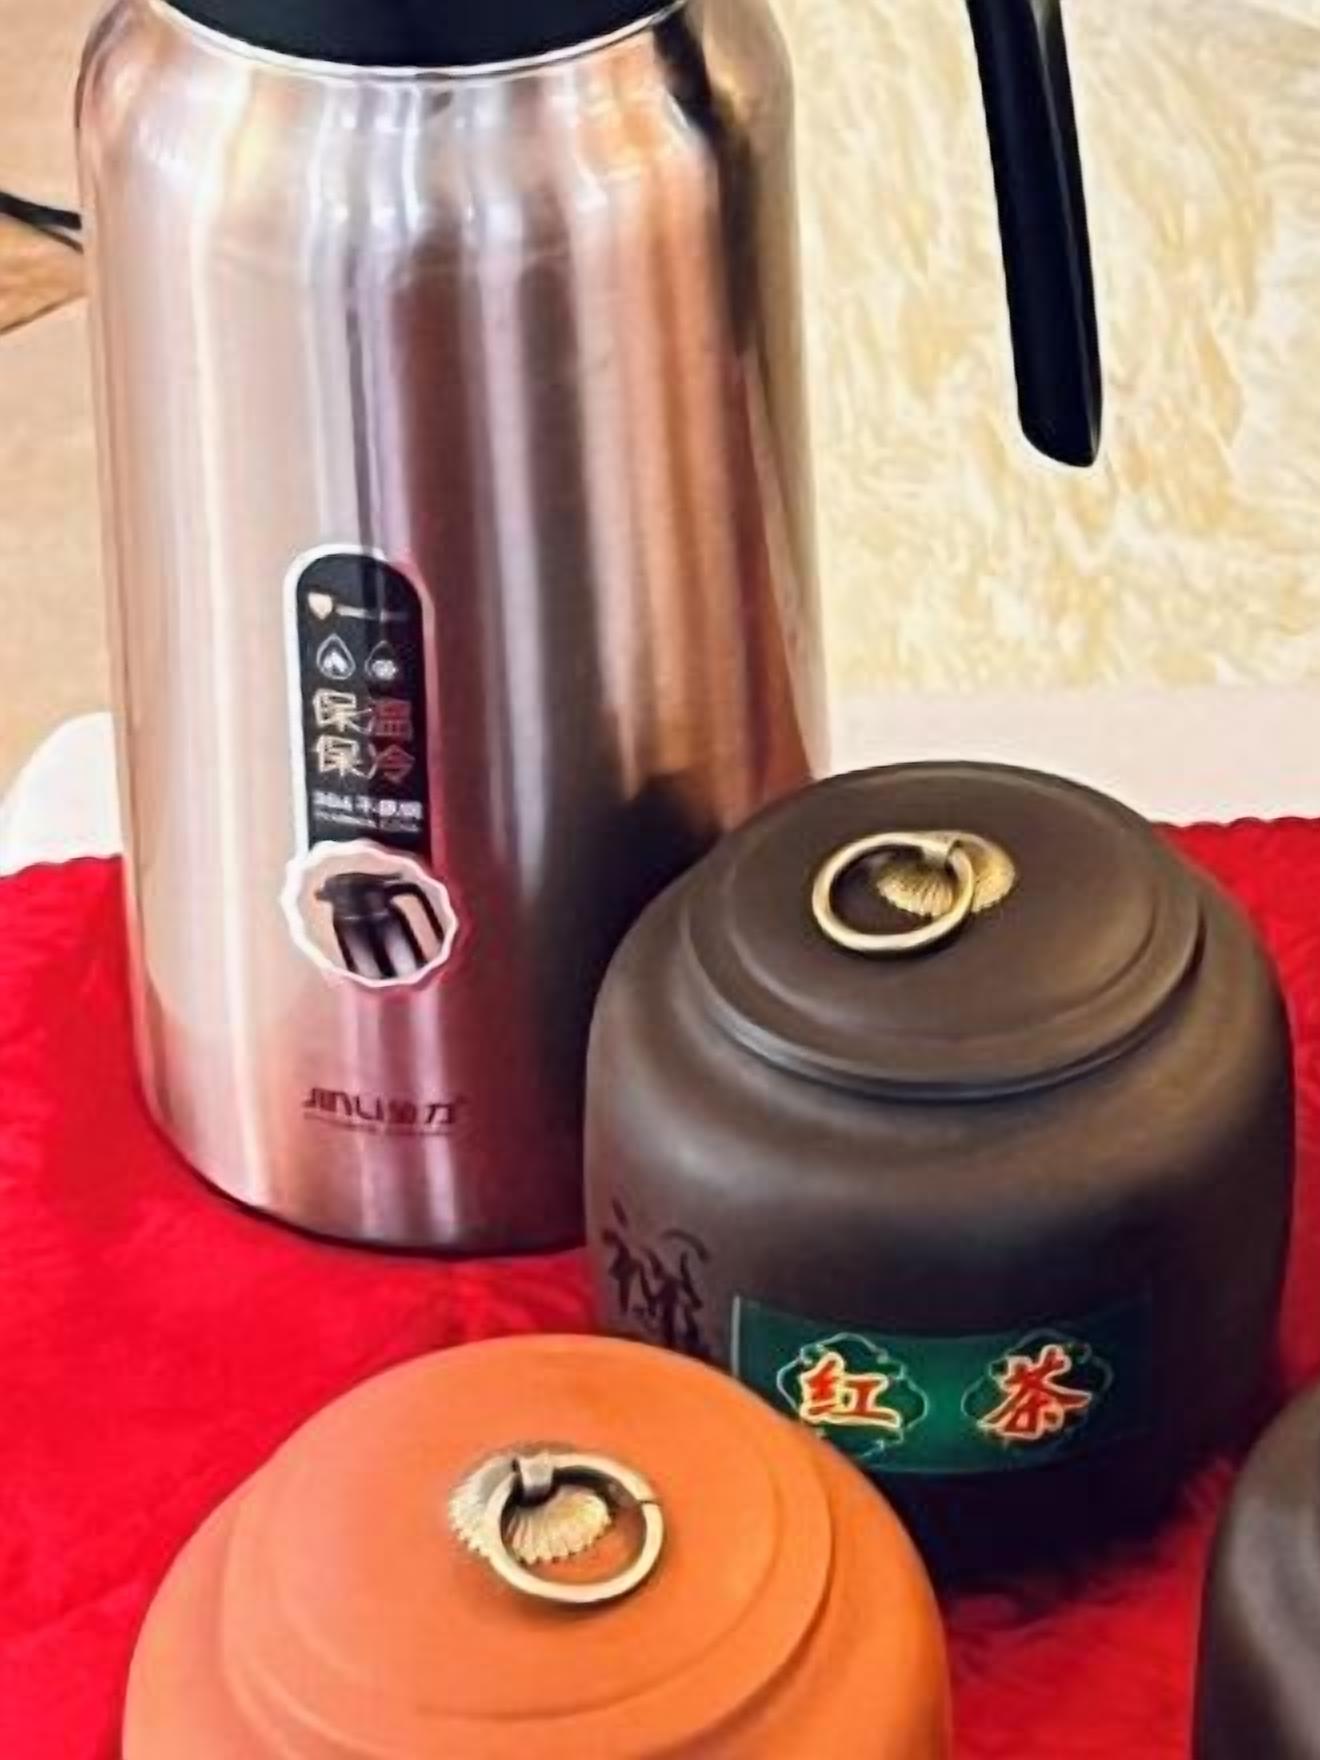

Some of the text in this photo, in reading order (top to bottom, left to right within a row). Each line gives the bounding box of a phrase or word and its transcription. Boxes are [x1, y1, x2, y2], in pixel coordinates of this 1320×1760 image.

[312, 688, 414, 741] 保温
[314, 734, 416, 783] 保冷
[799, 1344, 1093, 1439] 红茶
